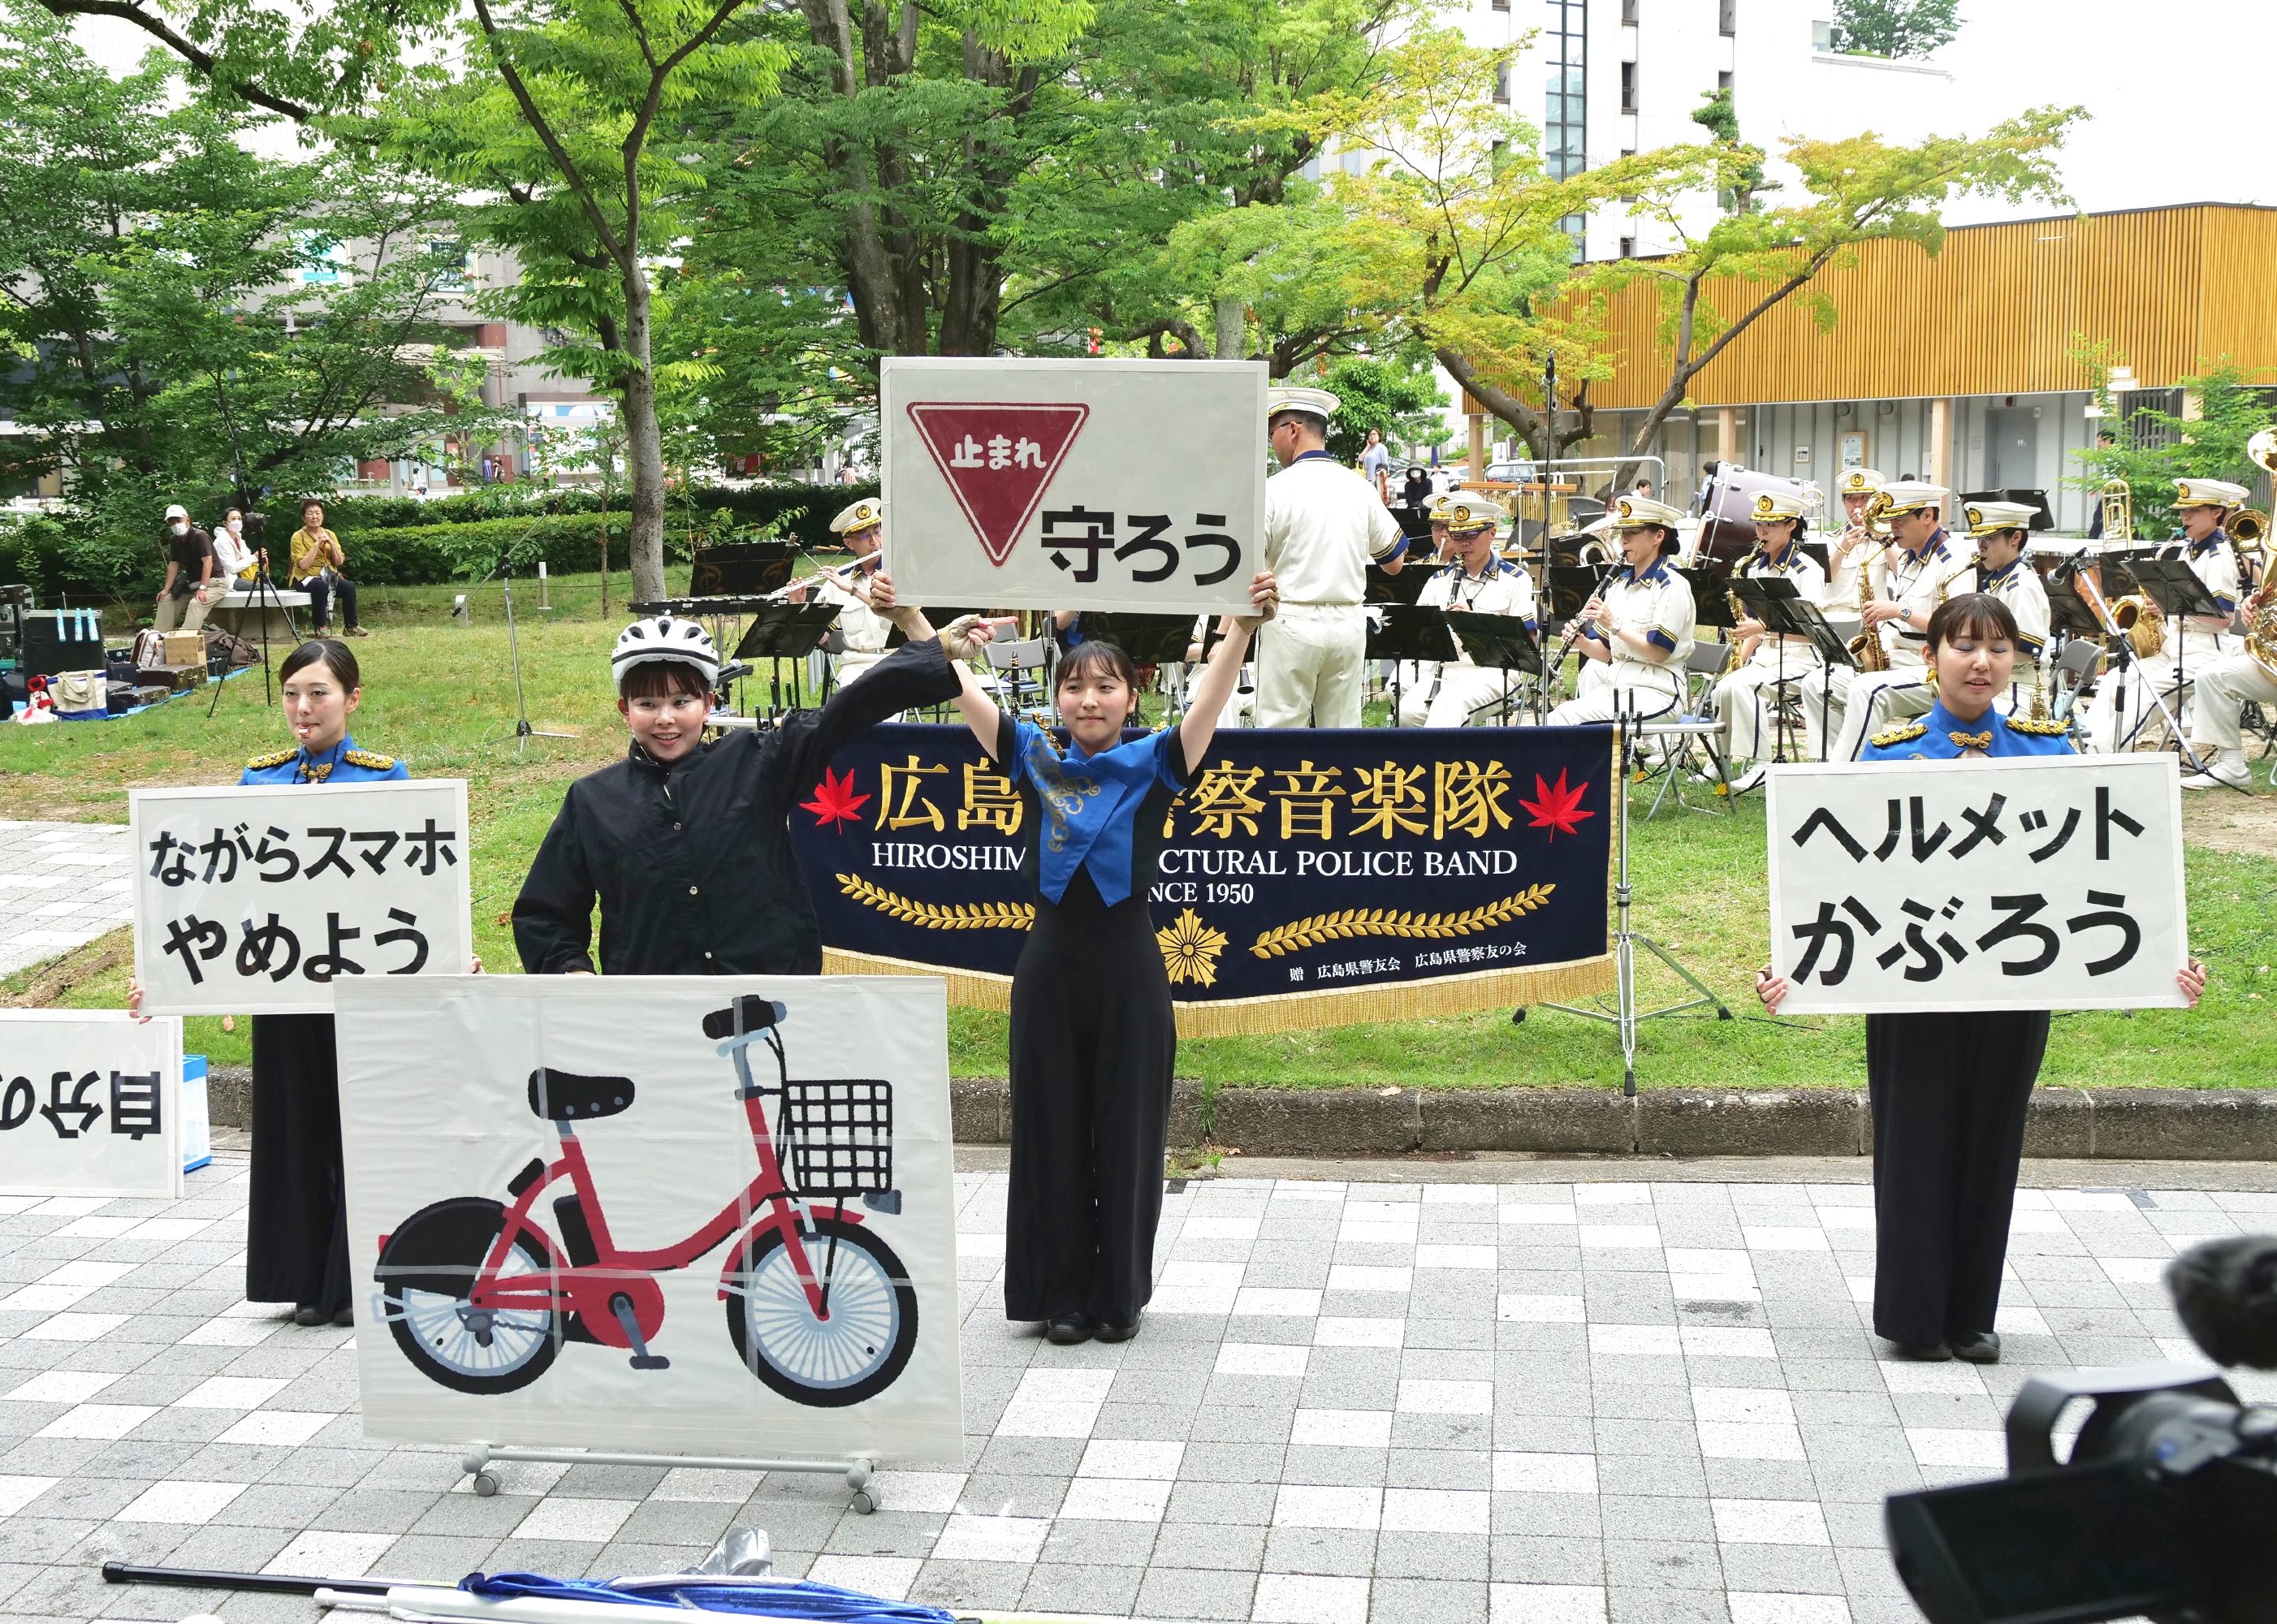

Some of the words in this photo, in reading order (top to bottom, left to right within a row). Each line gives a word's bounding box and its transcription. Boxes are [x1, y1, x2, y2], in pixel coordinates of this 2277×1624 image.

[949, 434, 1047, 470] 止まれ
[1040, 505, 1242, 586] 守ろう
[875, 754, 1514, 840] 広島察音楽隊
[1791, 786, 2145, 864] ヘルメット
[149, 818, 458, 888] ながらスマホ
[871, 842, 1026, 871] HIROSHIM
[1158, 849, 1287, 876] CTURAL
[1297, 850, 1414, 876] POLICE
[1424, 850, 1518, 876] BAND
[1147, 883, 1198, 904] NCE
[1206, 883, 1254, 905] 1950
[162, 907, 429, 986] やめよう
[1290, 967, 1304, 982] 贈
[1317, 957, 1401, 979] 広島県警友会
[1415, 941, 1527, 969] 広島県警察友の会
[1791, 889, 2141, 987] かぶろう
